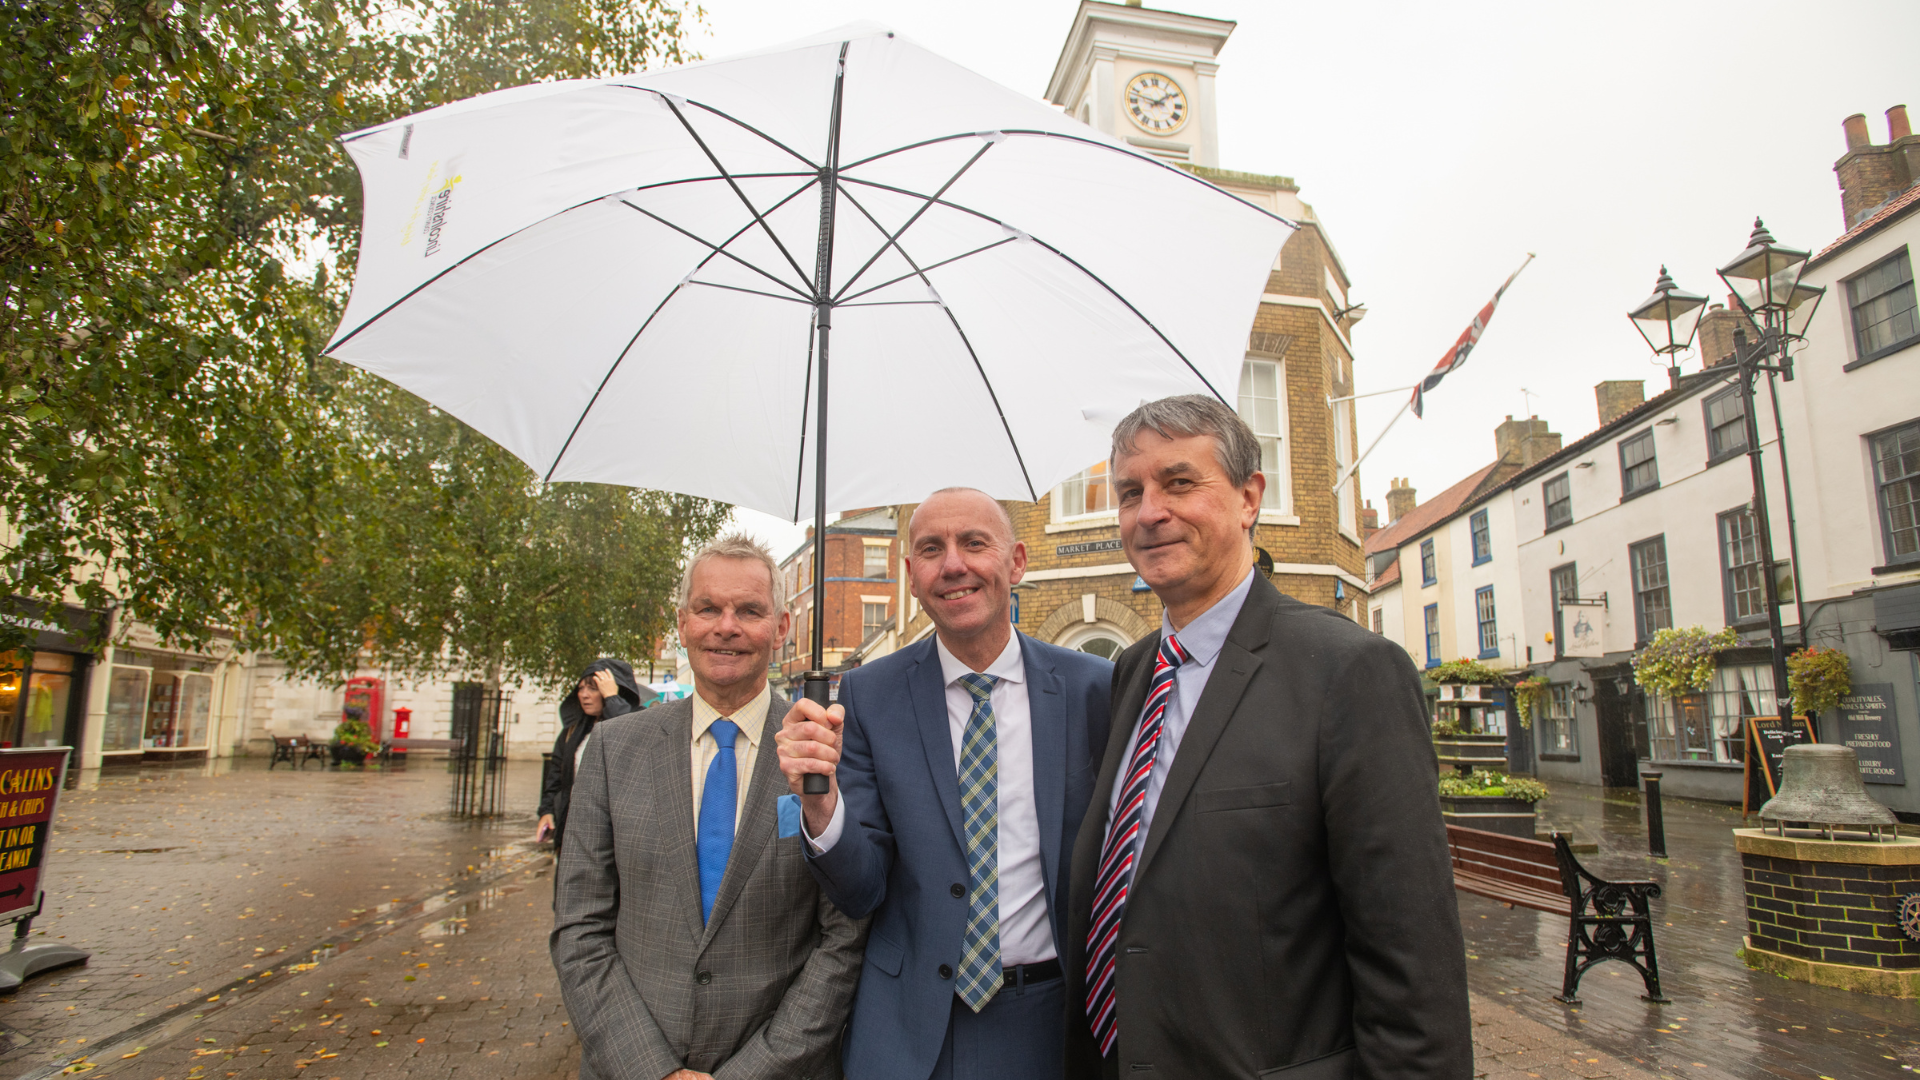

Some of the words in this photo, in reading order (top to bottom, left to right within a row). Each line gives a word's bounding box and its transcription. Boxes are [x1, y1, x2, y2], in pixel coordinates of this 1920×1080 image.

[1058, 544, 1090, 554] MARKET
[1096, 541, 1120, 550] PLACE
[8, 800, 18, 818] &
[18, 797, 46, 817] CHIPS
[5, 827, 21, 848] IN
[19, 825, 36, 846] OR
